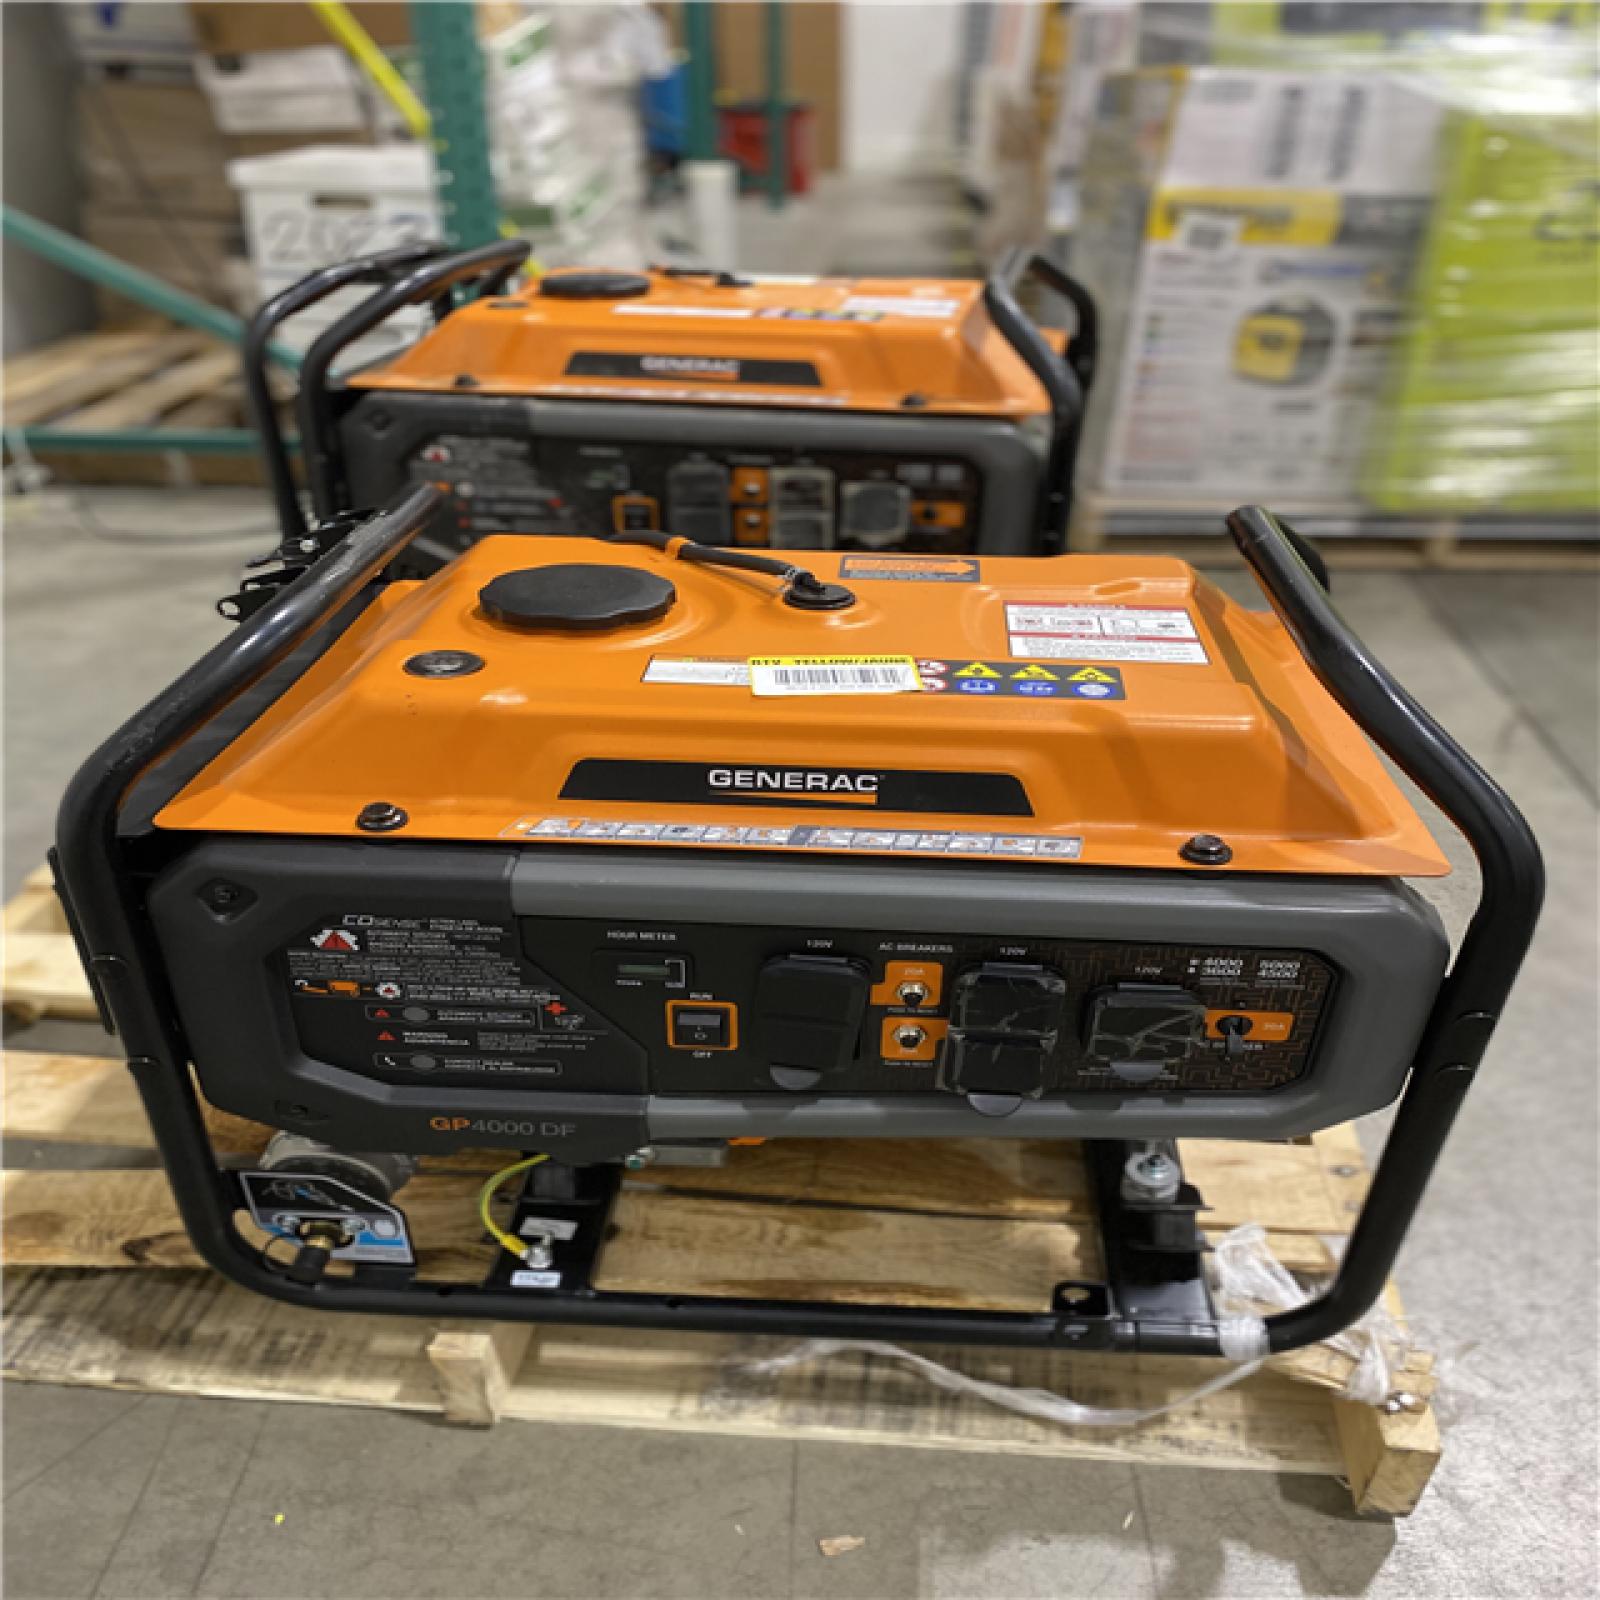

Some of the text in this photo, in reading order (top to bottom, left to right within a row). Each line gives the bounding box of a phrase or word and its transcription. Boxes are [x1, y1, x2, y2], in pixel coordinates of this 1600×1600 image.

[709, 769, 879, 791] GENERAC
[606, 930, 677, 941] HOUR METER
[807, 939, 833, 949] 120V
[878, 942, 954, 954] AC BREAKERS
[999, 946, 1028, 956] 120V
[429, 1116, 578, 1137] GP4000 DF
